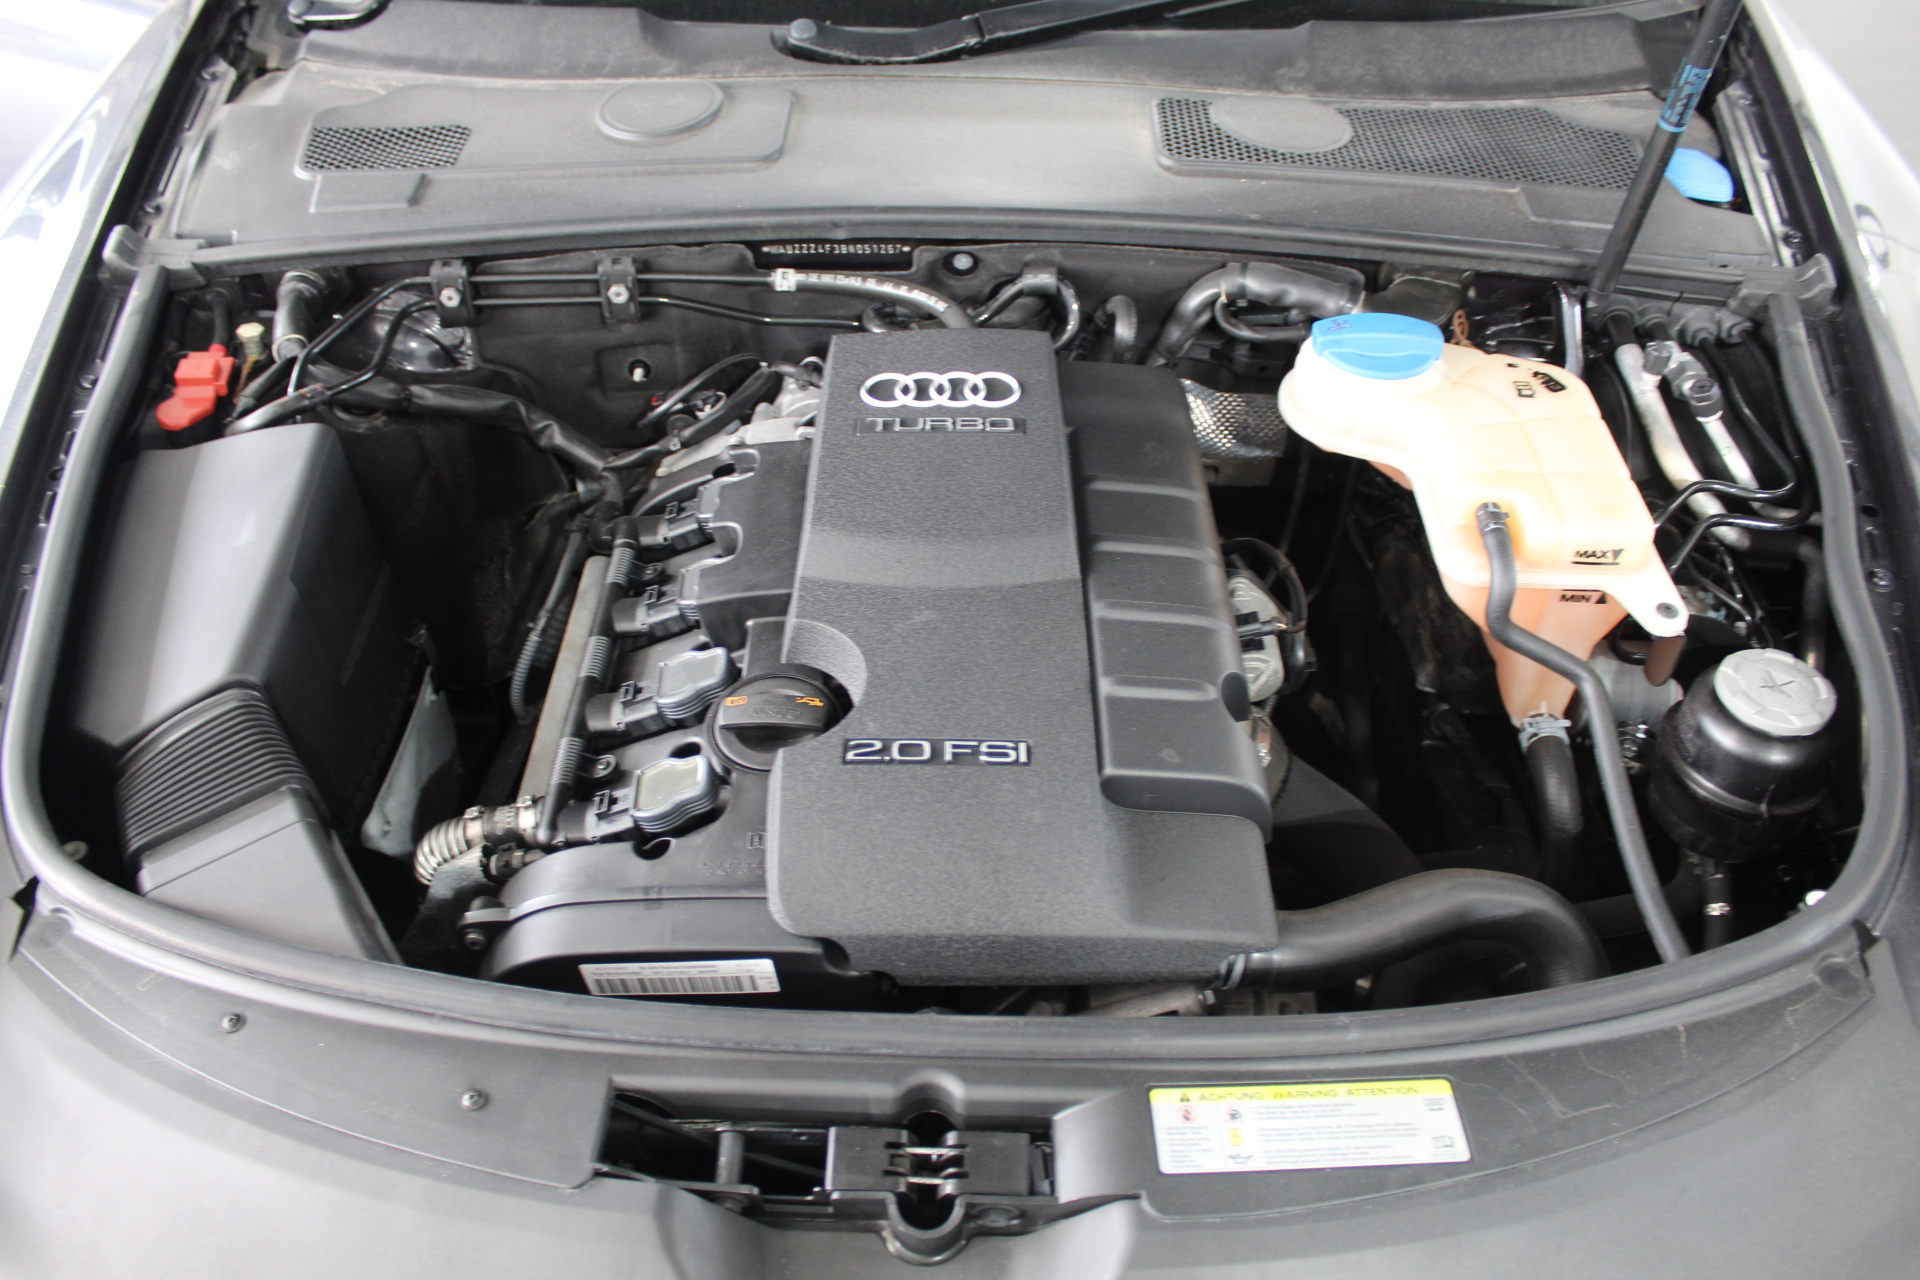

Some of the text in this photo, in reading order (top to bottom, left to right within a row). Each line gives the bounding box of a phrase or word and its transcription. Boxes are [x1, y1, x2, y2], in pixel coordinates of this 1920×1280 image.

[866, 417, 1015, 432] TURBO
[1574, 550, 1609, 559] MAX
[1559, 594, 1593, 603] MIN
[845, 739, 1028, 765] 2.0 FSI
[1198, 1086, 1419, 1101] ACHTUNG WARNING ATTENTION
